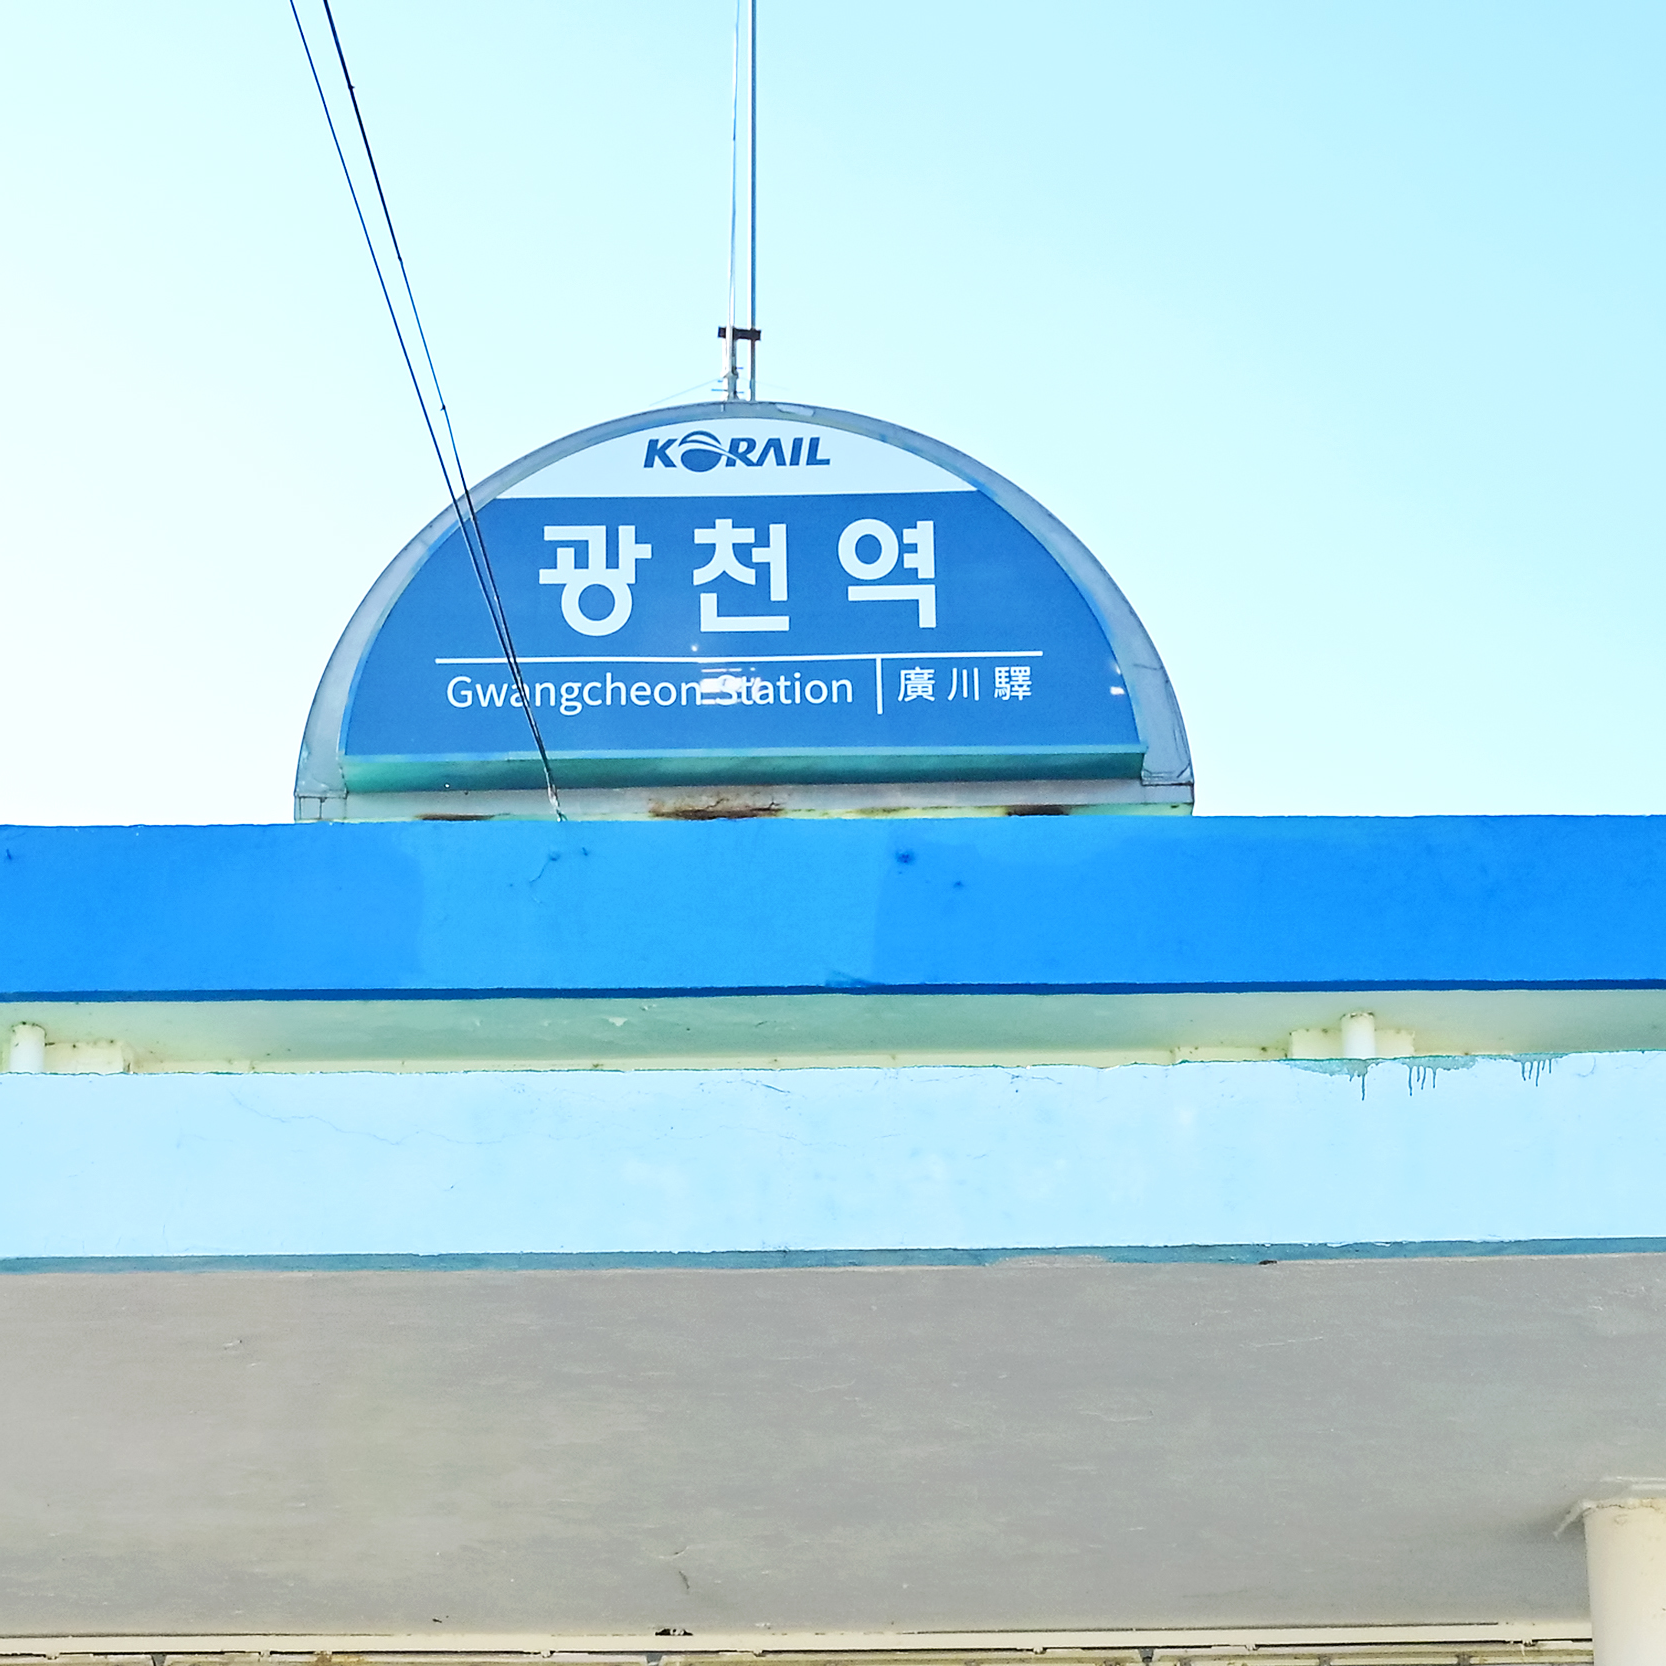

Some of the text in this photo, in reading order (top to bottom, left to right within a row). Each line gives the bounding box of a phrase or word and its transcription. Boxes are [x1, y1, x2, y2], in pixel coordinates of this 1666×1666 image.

[643, 430, 831, 472] KORAIL
[446, 671, 853, 716] Gwangcheon Station
